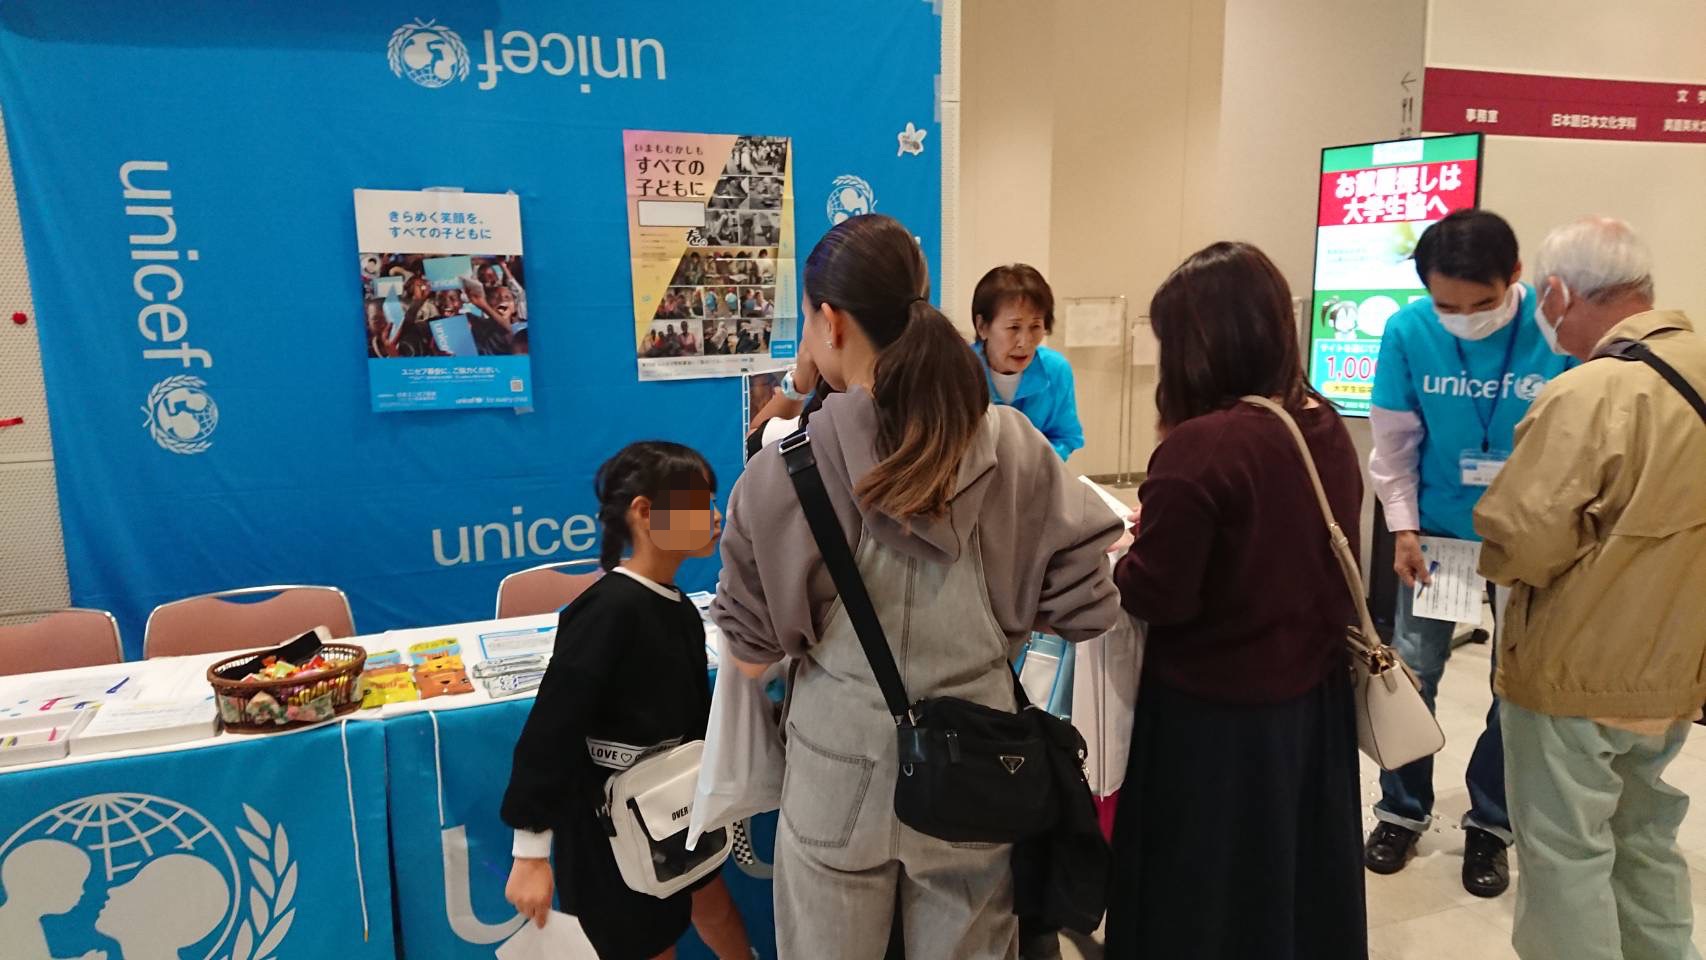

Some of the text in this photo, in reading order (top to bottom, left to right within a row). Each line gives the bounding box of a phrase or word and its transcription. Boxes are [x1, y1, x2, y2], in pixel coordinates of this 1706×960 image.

[478, 29, 666, 93] unicef
[1465, 108, 1499, 123] 事務室
[634, 143, 704, 156] いまもむかしも
[636, 157, 705, 176] すべての
[636, 179, 705, 197] 子どもに
[1335, 163, 1462, 198] お部屋探しは
[1343, 192, 1448, 224] 大学生協へ
[388, 226, 493, 240] すべての子どもに
[119, 160, 213, 368] unicef
[1423, 369, 1515, 399] unicef
[432, 506, 600, 566] unice
[591, 747, 618, 761] LOVE
[671, 806, 689, 821] OVER
